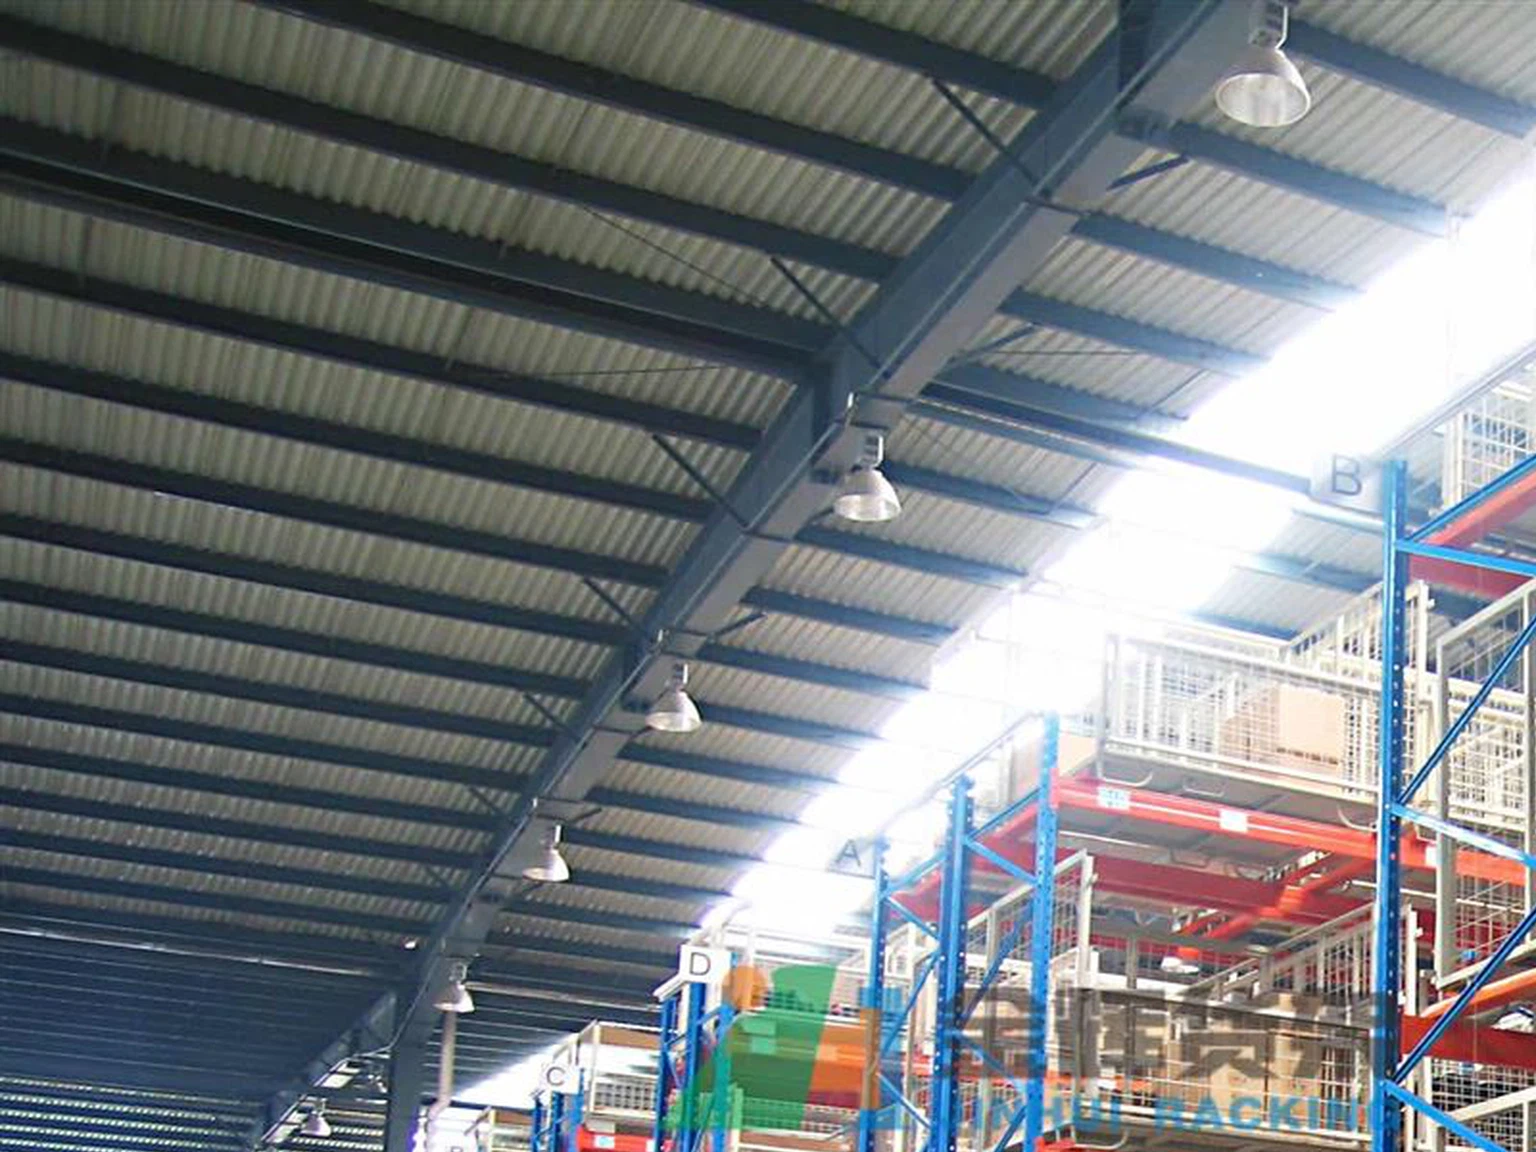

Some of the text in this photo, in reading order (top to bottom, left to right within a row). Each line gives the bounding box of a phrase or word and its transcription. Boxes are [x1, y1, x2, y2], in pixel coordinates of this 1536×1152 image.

[1330, 453, 1363, 496] B
[832, 838, 862, 868] A
[688, 953, 712, 976] D
[545, 1065, 566, 1086] C
